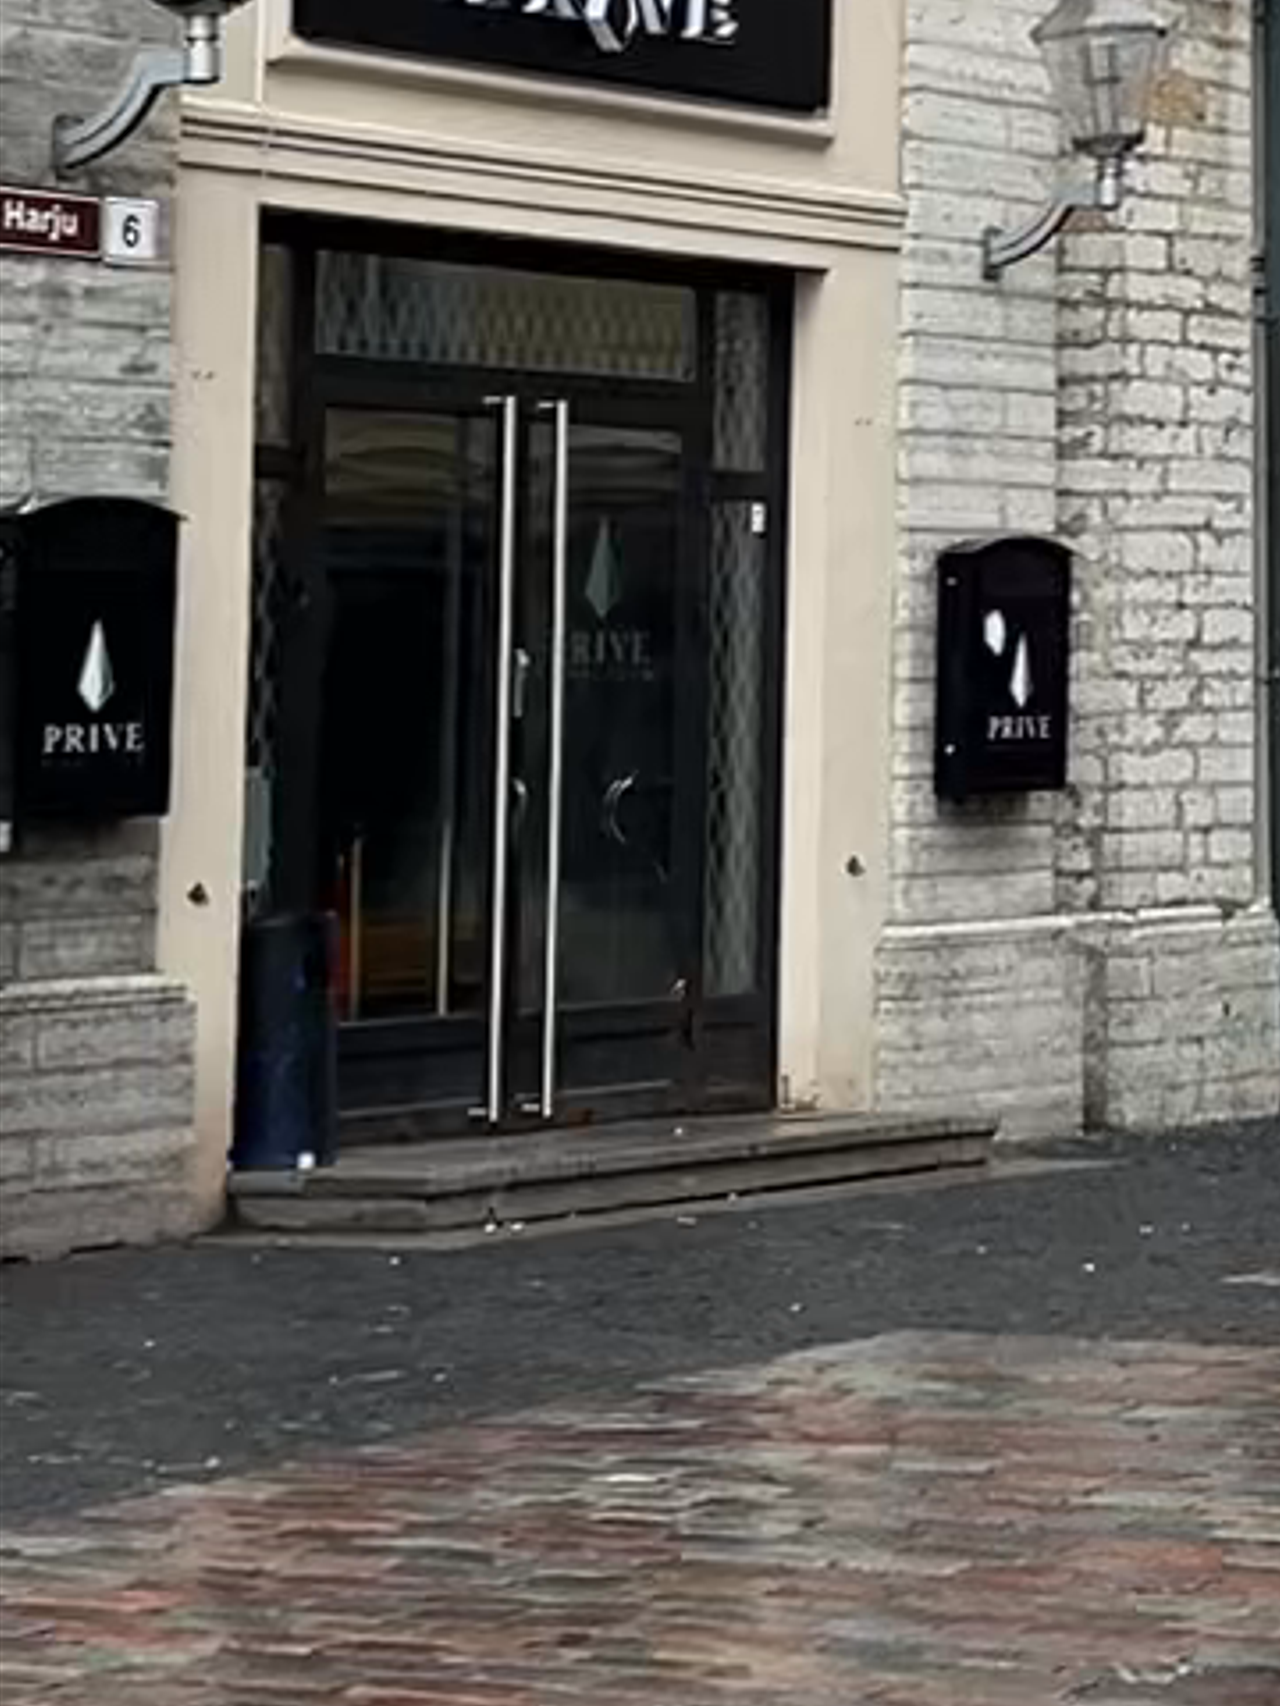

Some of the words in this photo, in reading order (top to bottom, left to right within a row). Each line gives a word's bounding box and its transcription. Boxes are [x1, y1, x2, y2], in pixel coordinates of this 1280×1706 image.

[4, 199, 78, 241] Harju
[122, 214, 141, 248] 6
[42, 723, 145, 753] PRIVE
[988, 716, 1051, 740] PRIVE
